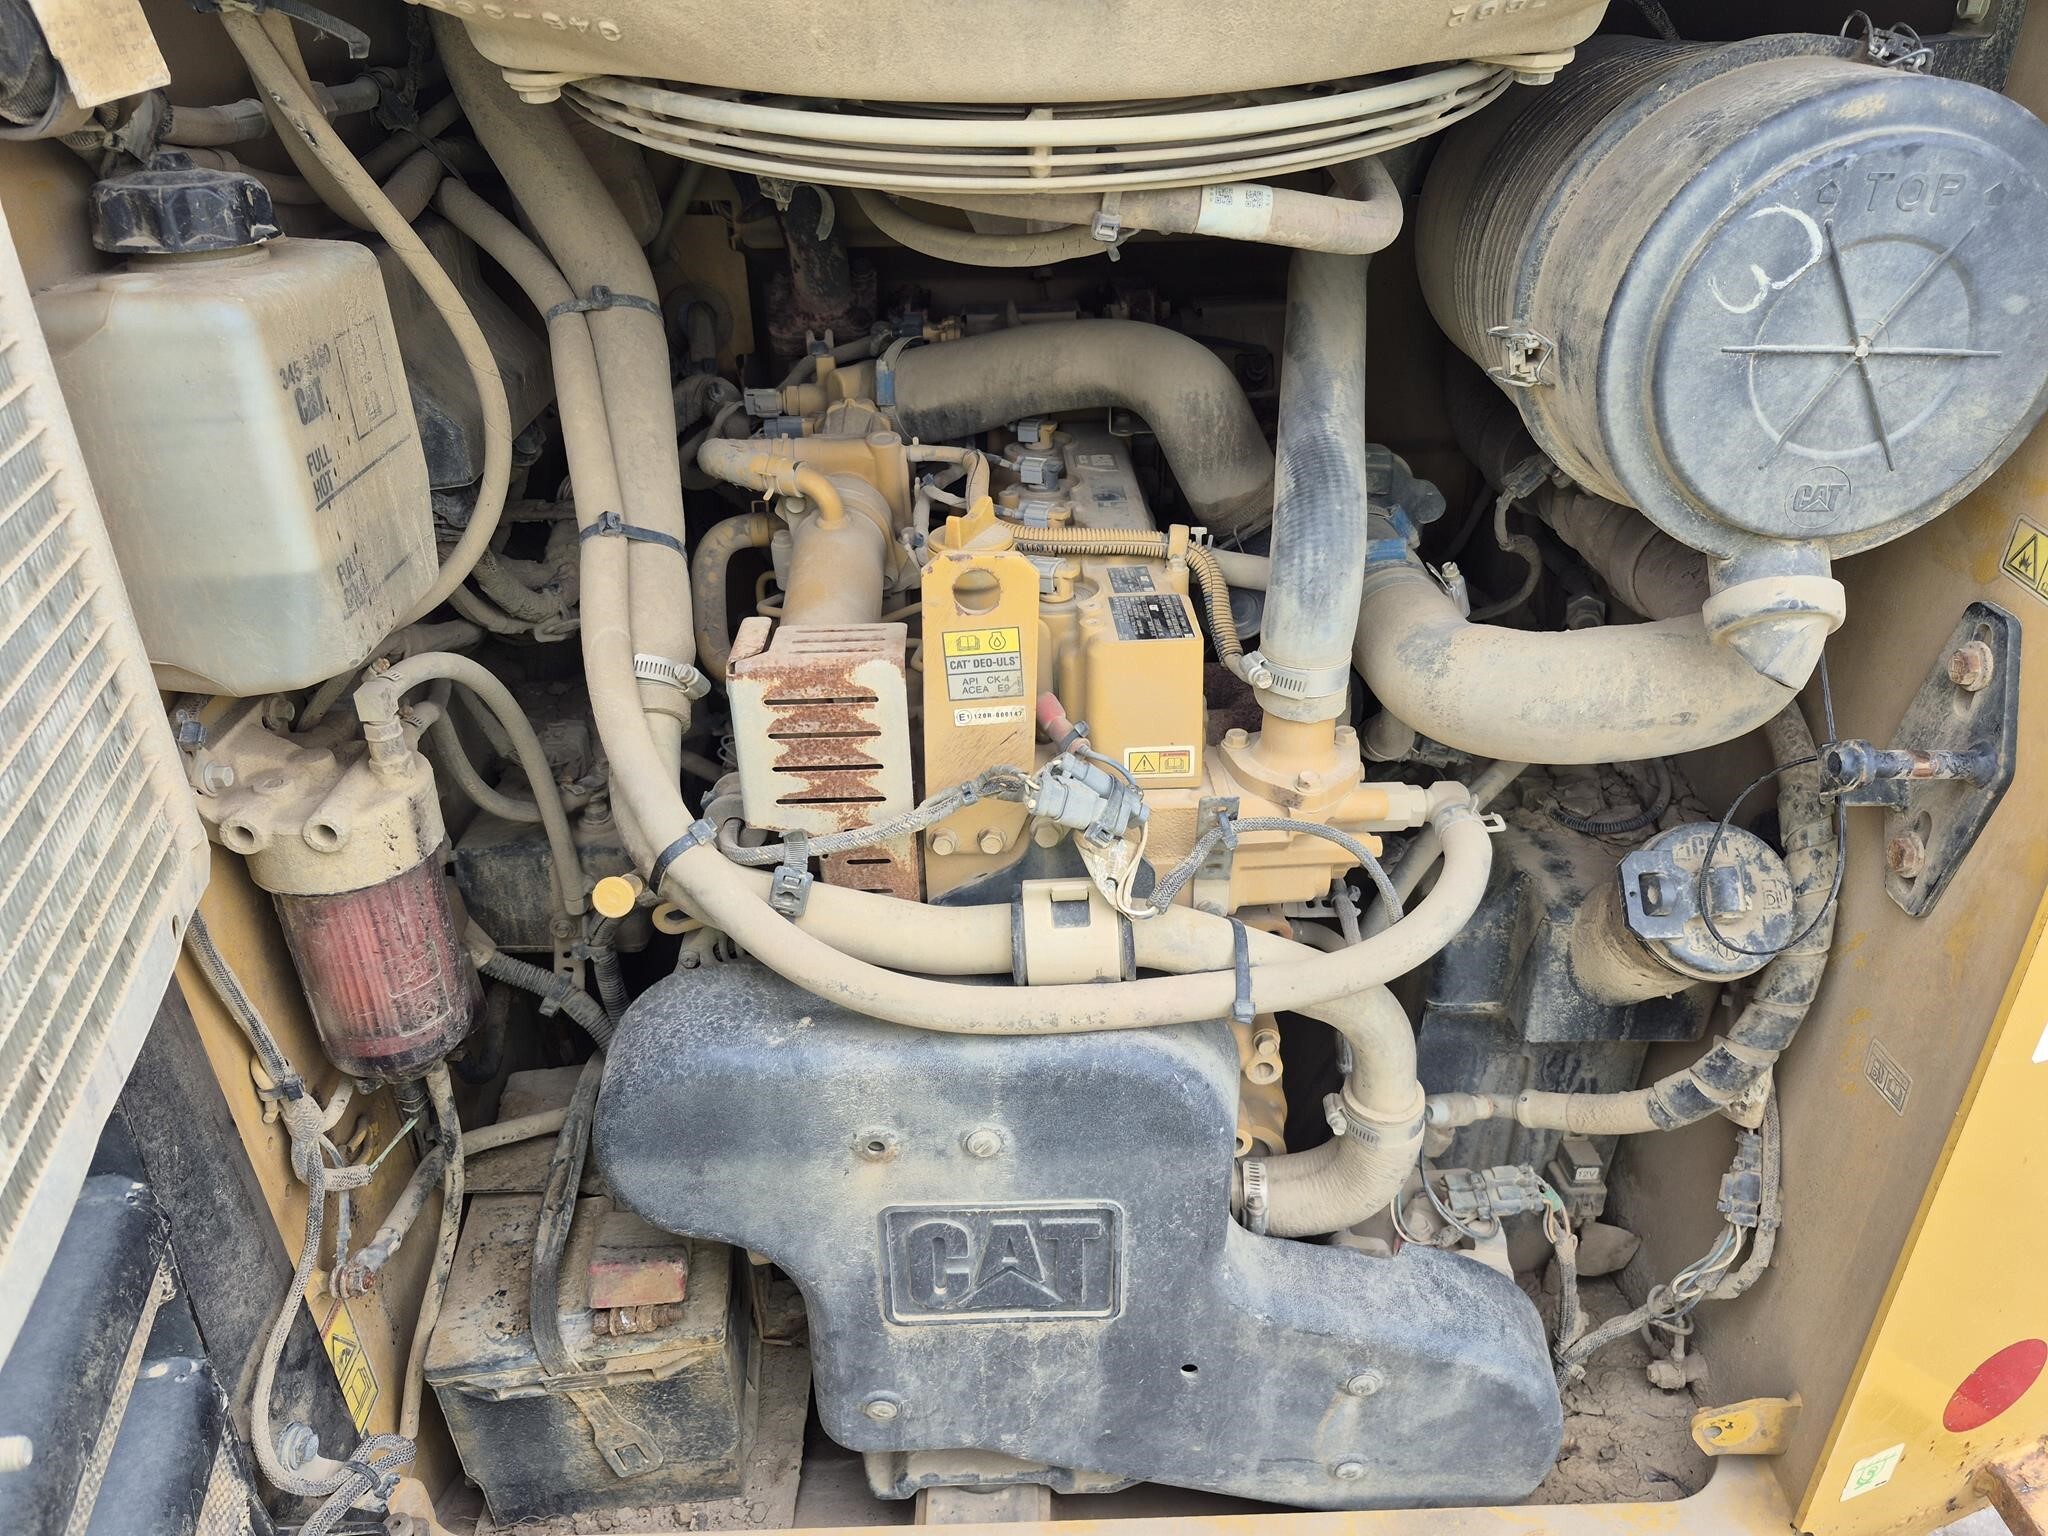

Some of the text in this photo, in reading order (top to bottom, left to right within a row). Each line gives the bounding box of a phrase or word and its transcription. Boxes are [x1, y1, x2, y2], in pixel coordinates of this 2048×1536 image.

[1866, 171, 1967, 214] TOP
[306, 443, 332, 477] FULL
[313, 469, 334, 501] HOT
[1793, 484, 1846, 513] CAT
[336, 552, 358, 587] FULL
[961, 686, 989, 694] ACEA
[997, 684, 1010, 693] E9
[962, 677, 978, 686] API
[986, 675, 1010, 685] CK-4
[904, 1218, 1101, 1310] CAT
